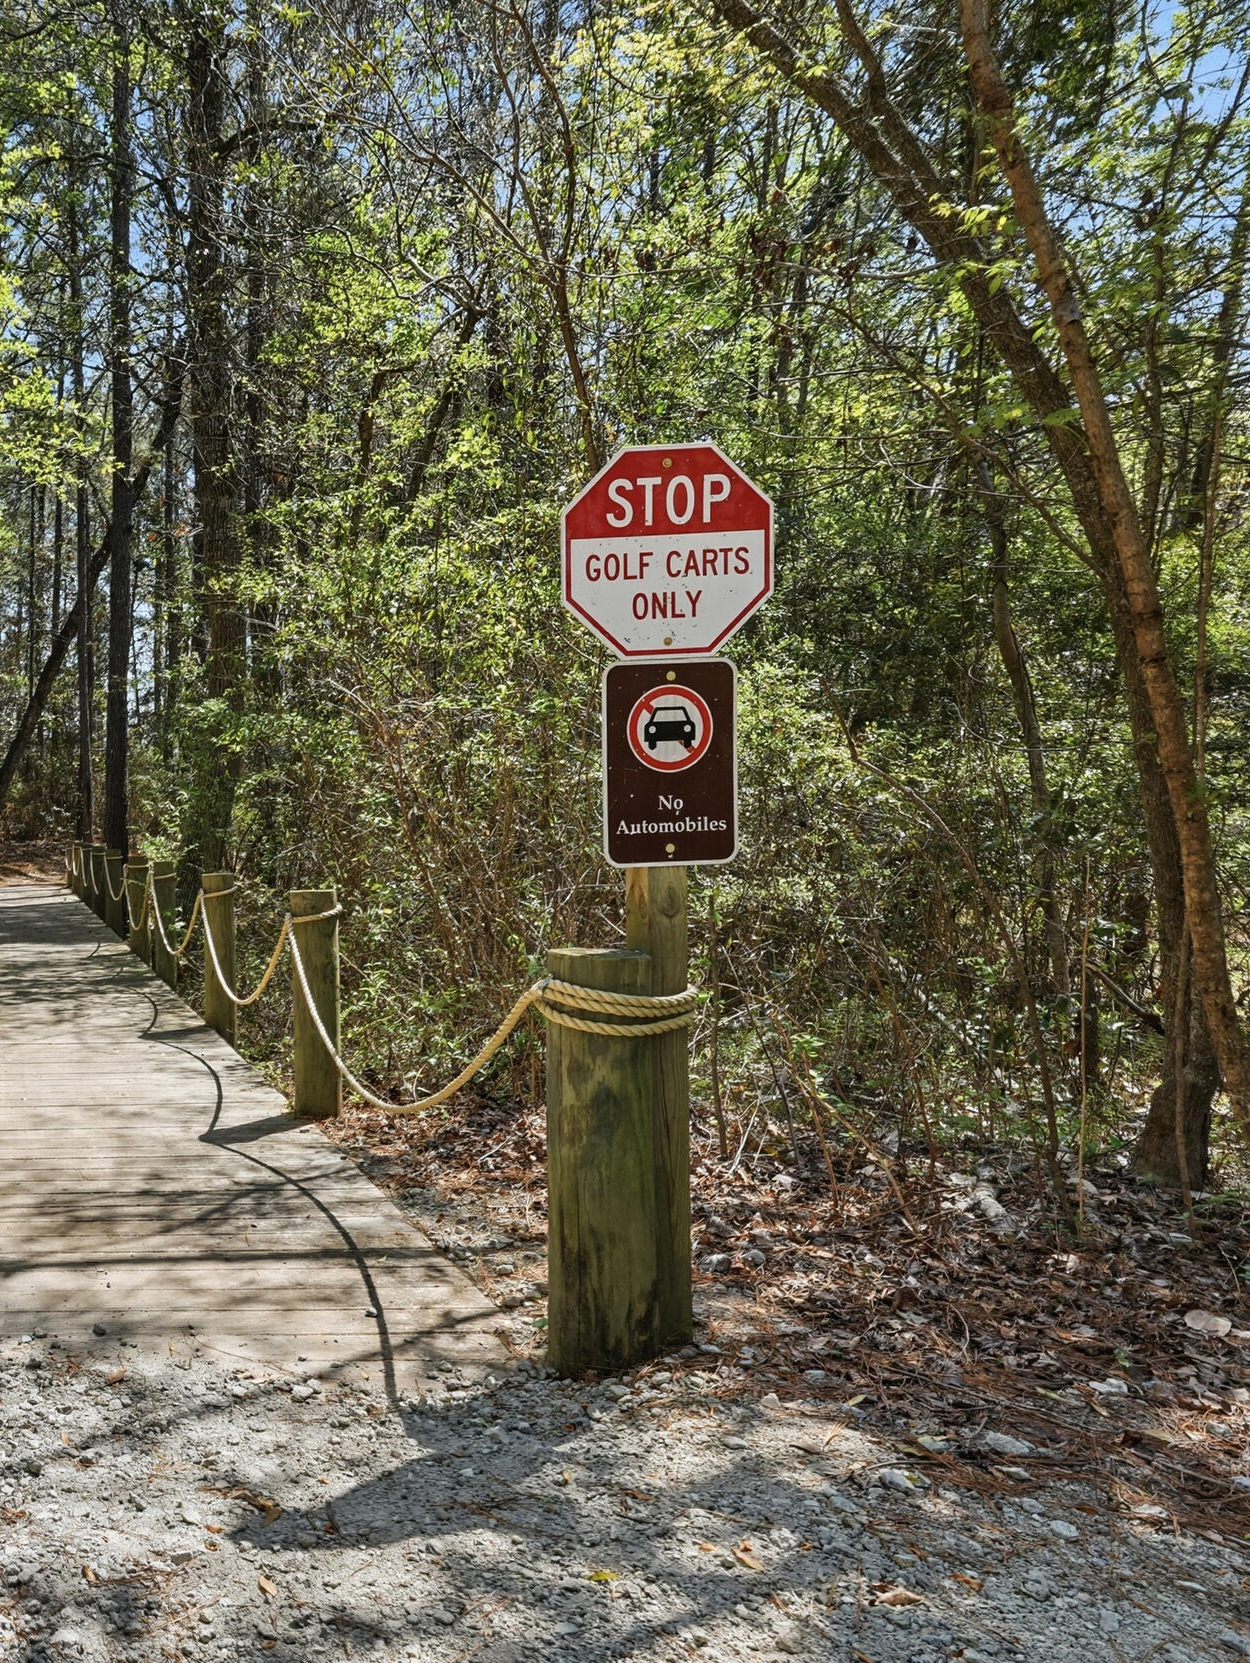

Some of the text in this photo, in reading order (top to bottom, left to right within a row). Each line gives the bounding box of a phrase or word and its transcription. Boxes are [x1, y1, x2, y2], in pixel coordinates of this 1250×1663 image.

[606, 473, 731, 528] STOP
[585, 547, 750, 582] GOLF CARTS
[632, 590, 703, 620] ONLY
[657, 795, 684, 811] No
[616, 816, 727, 835] Automobiles
